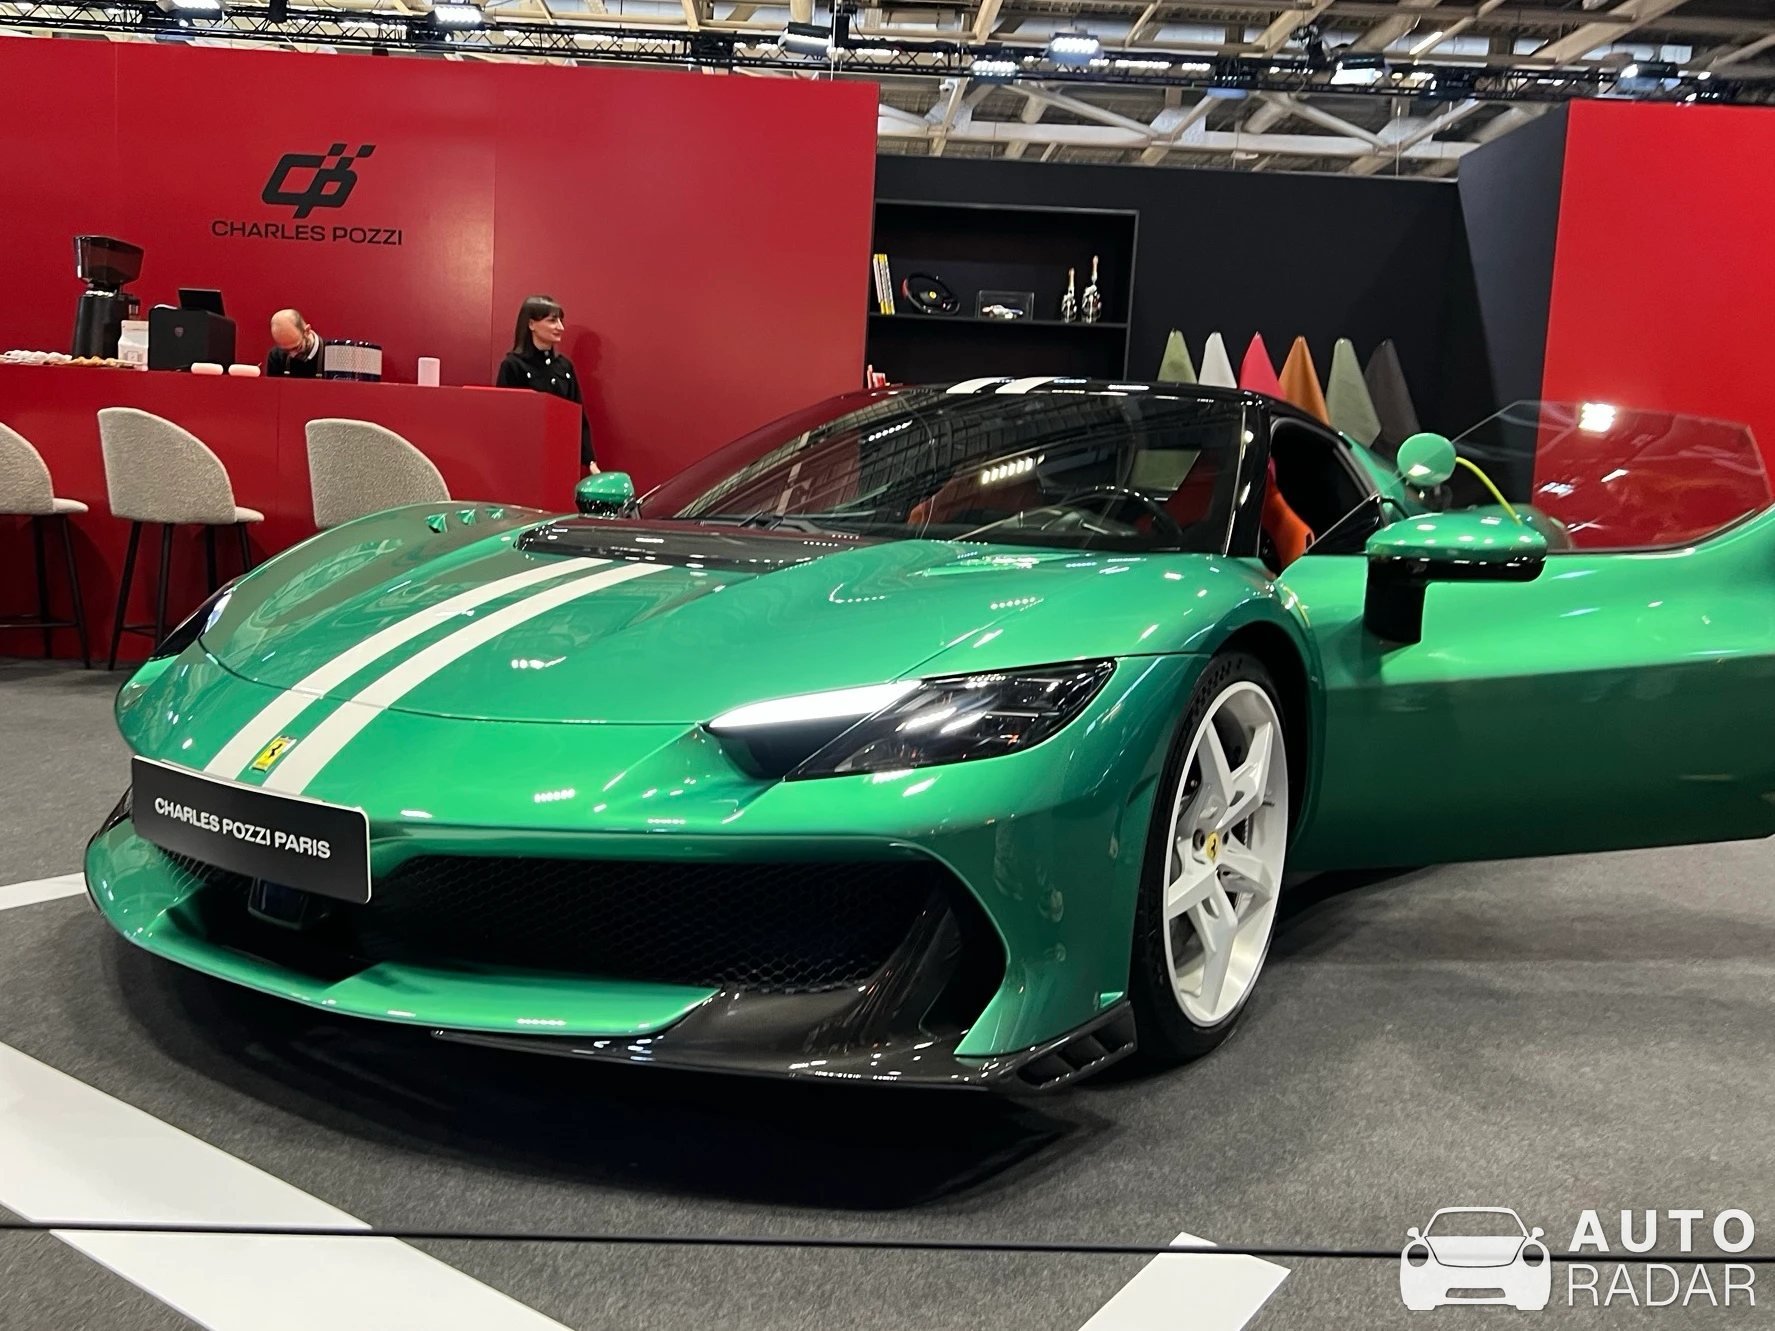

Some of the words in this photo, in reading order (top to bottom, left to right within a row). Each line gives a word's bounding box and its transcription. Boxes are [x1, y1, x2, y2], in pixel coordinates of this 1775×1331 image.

[211, 220, 326, 242] CHARLES
[332, 226, 402, 246] POZZI
[154, 797, 220, 833] CHARLES
[222, 818, 271, 846] POZZI
[274, 830, 331, 859] PARIS
